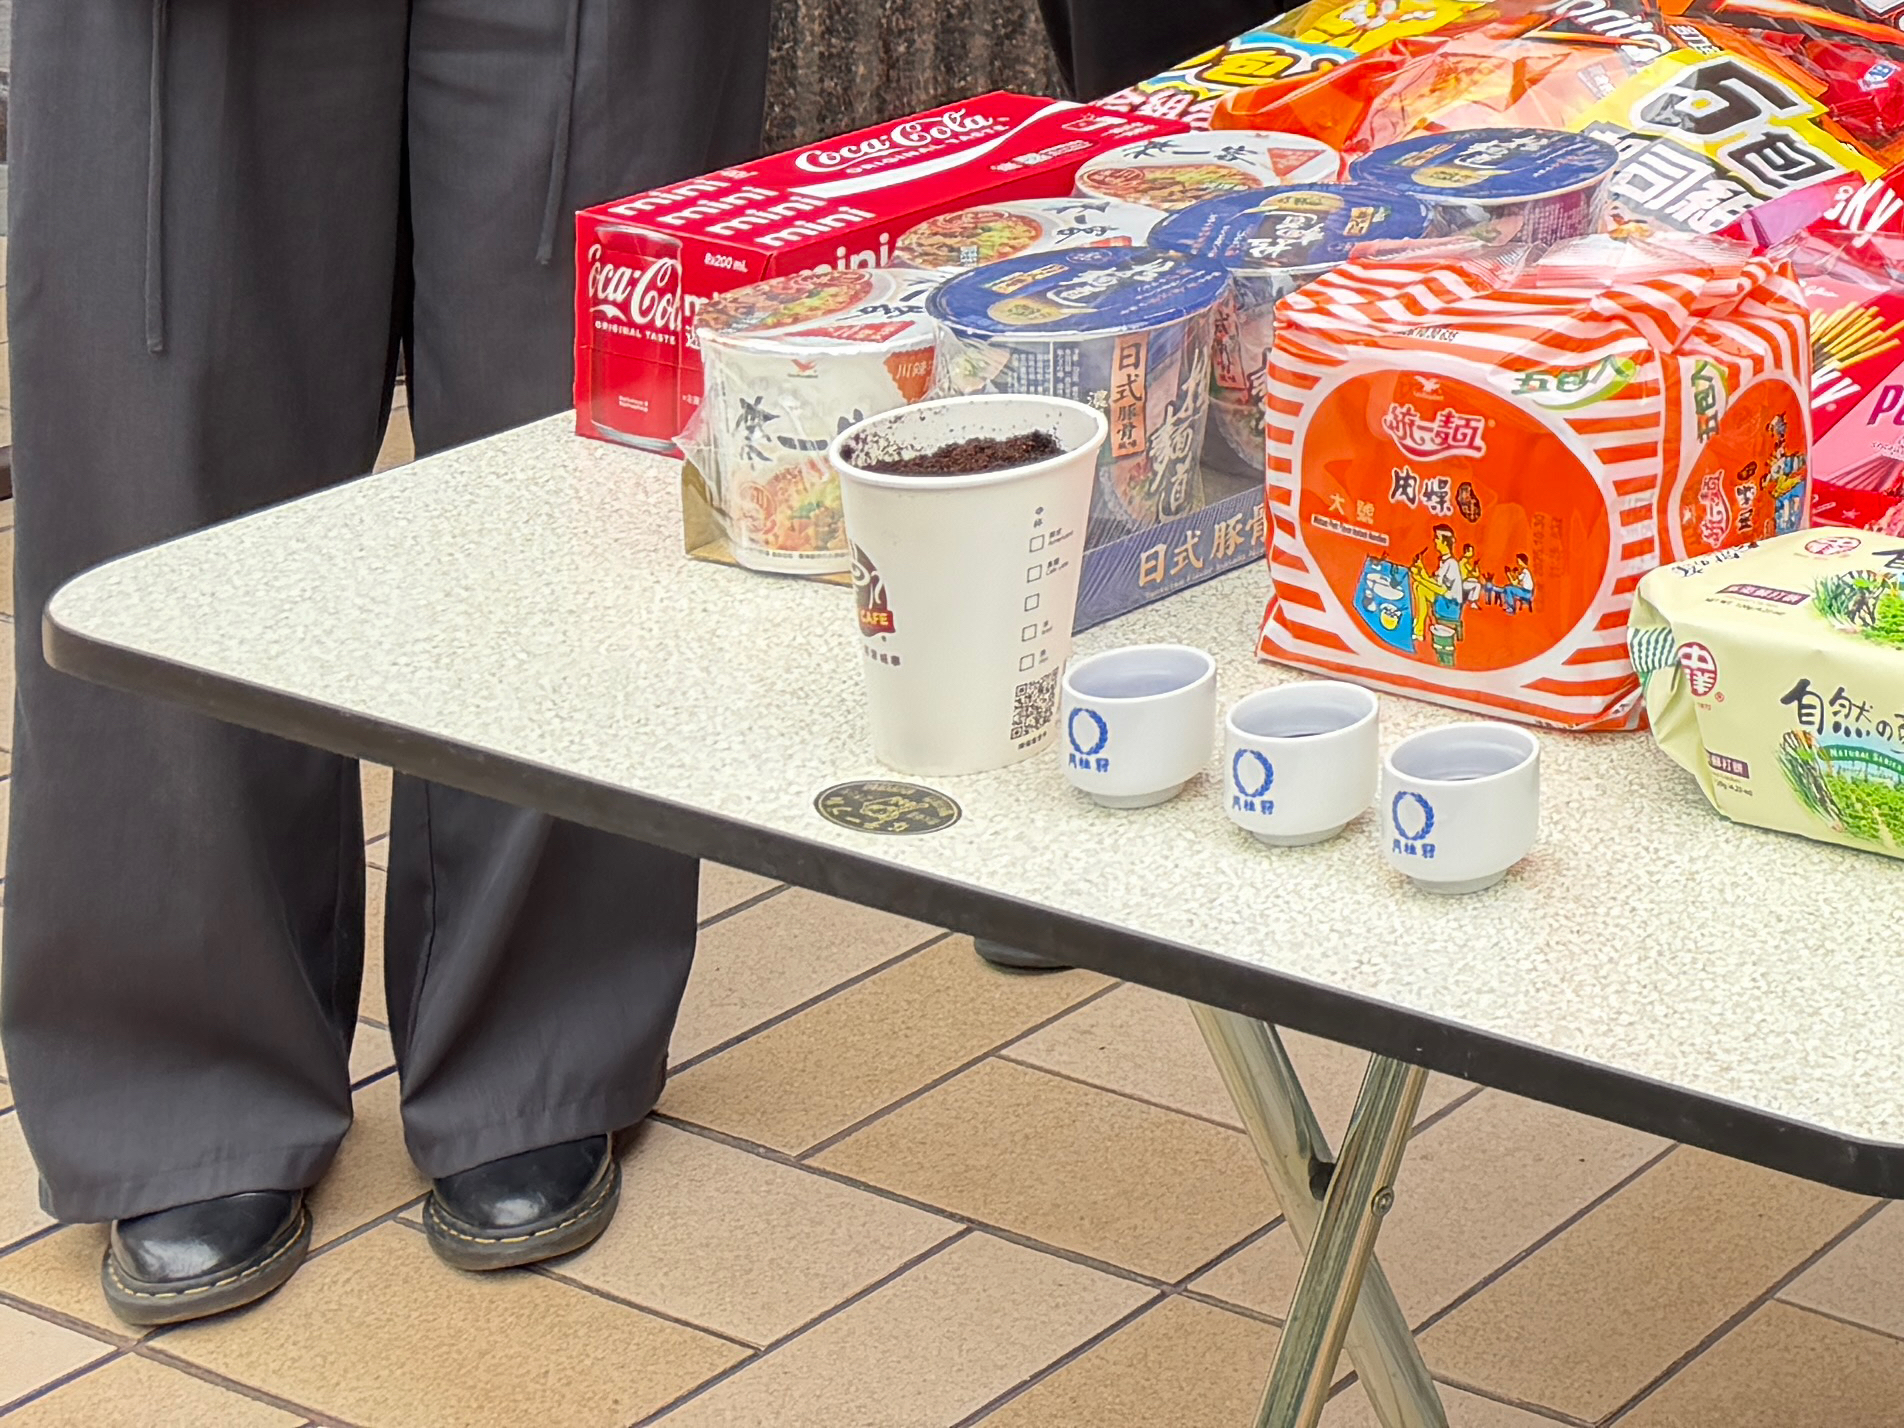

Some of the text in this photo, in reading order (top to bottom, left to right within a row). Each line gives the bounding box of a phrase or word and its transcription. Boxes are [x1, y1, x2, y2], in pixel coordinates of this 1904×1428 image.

[796, 107, 995, 173] Coca-Cola
[608, 178, 733, 217] mini
[655, 185, 780, 227] mini
[704, 195, 829, 237] mini
[753, 206, 878, 247] mini
[1067, 752, 1110, 774] 月桂冠
[1231, 795, 1274, 816] 月桂冠
